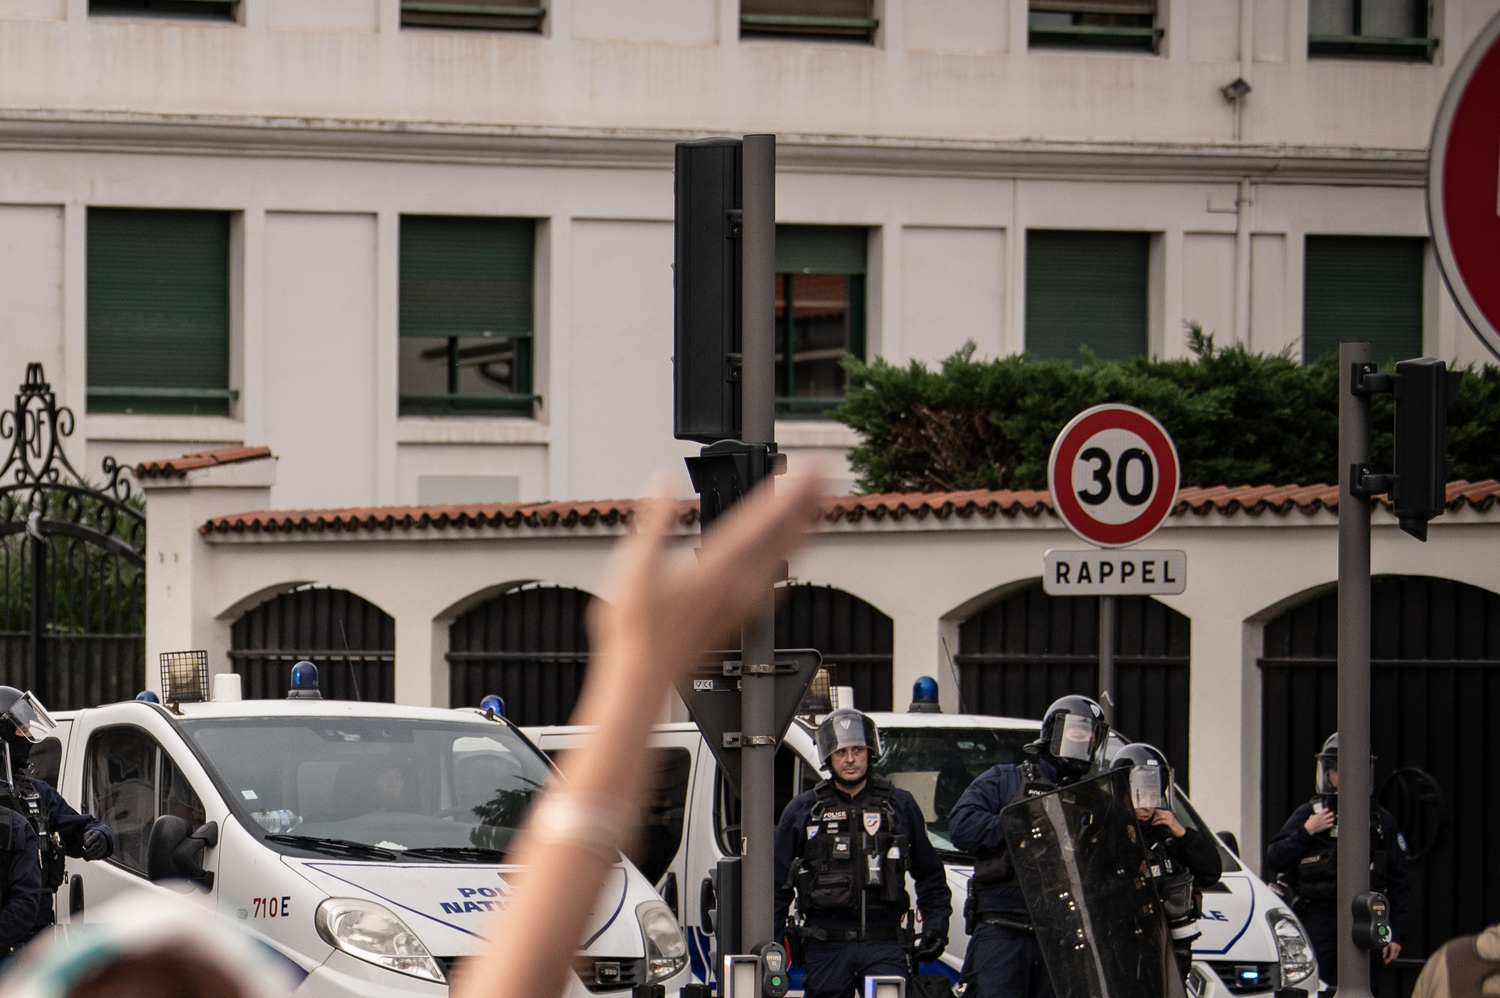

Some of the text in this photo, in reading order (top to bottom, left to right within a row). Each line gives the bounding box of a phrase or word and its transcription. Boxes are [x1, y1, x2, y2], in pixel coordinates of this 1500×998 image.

[1077, 447, 1154, 507] 30
[1056, 561, 1176, 585] RAPPEL
[823, 811, 847, 819] POLICE
